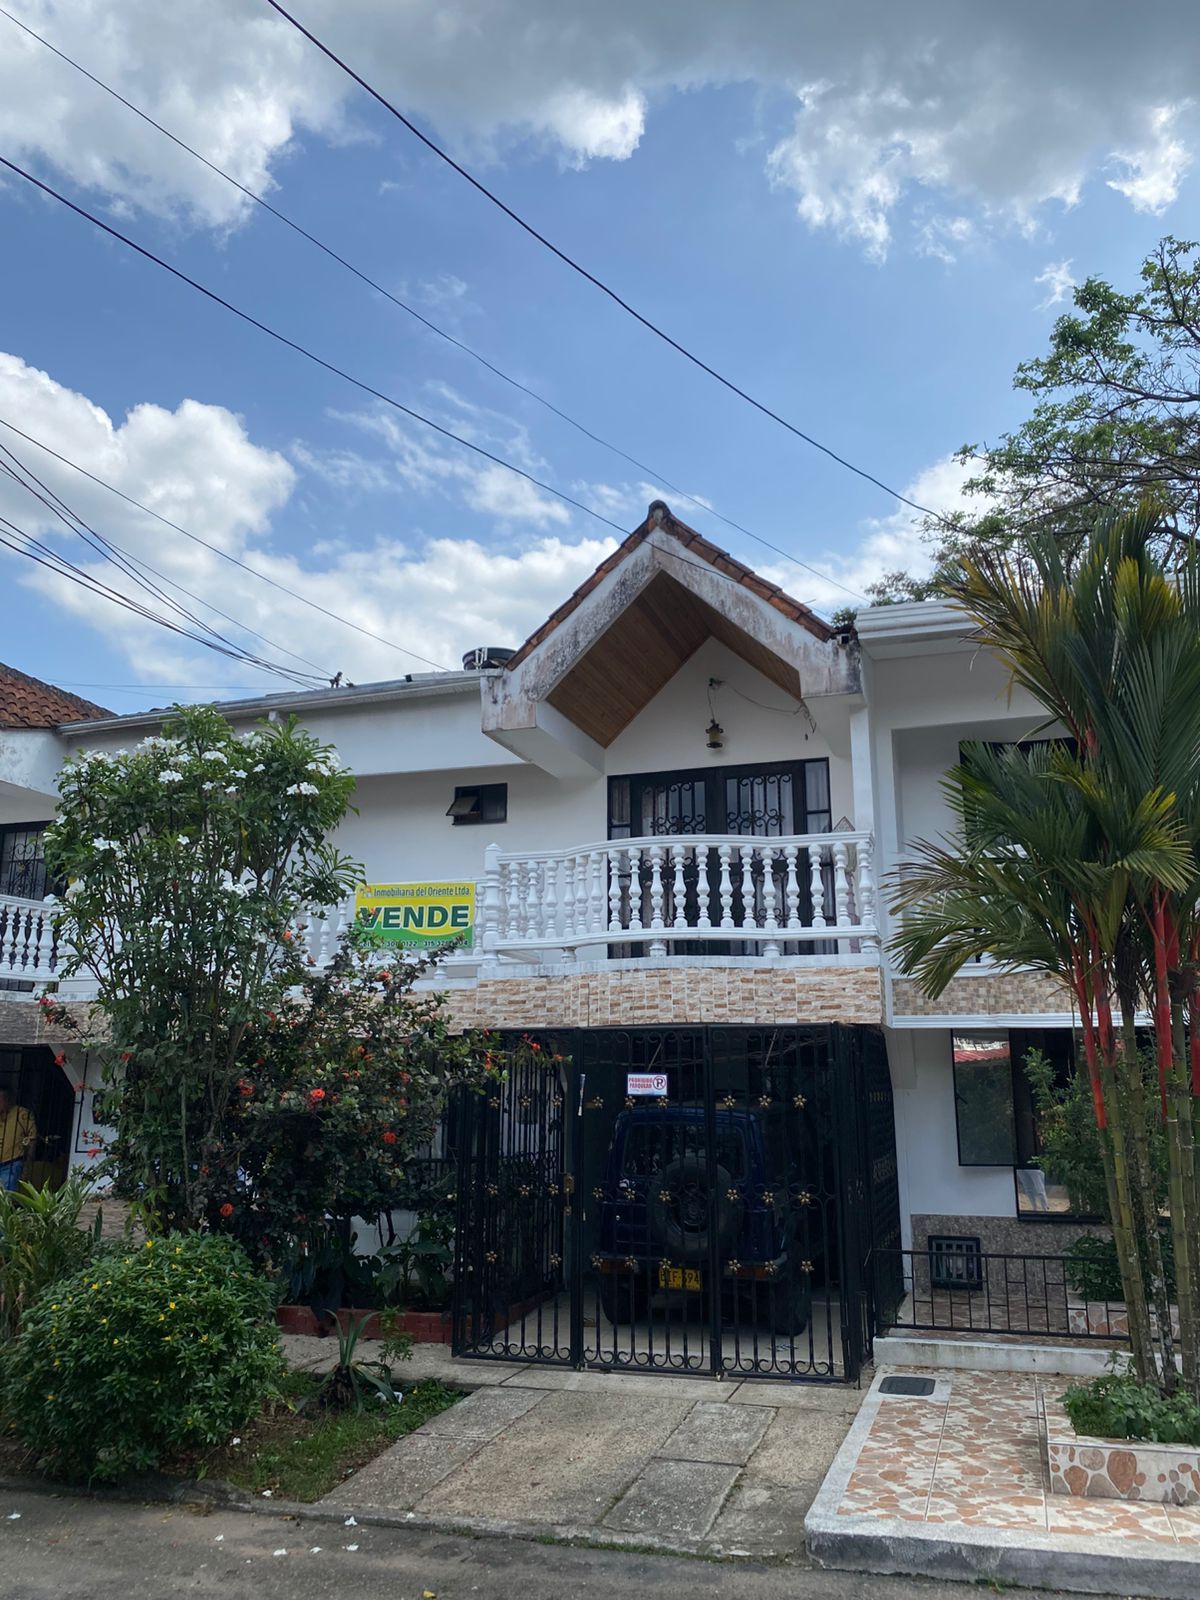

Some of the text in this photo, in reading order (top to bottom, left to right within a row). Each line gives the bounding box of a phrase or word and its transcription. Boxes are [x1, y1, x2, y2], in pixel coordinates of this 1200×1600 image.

[374, 888, 414, 897] Inmobiliaria
[416, 887, 426, 896] del
[428, 886, 453, 896] Oriente
[360, 905, 469, 928] VENDE
